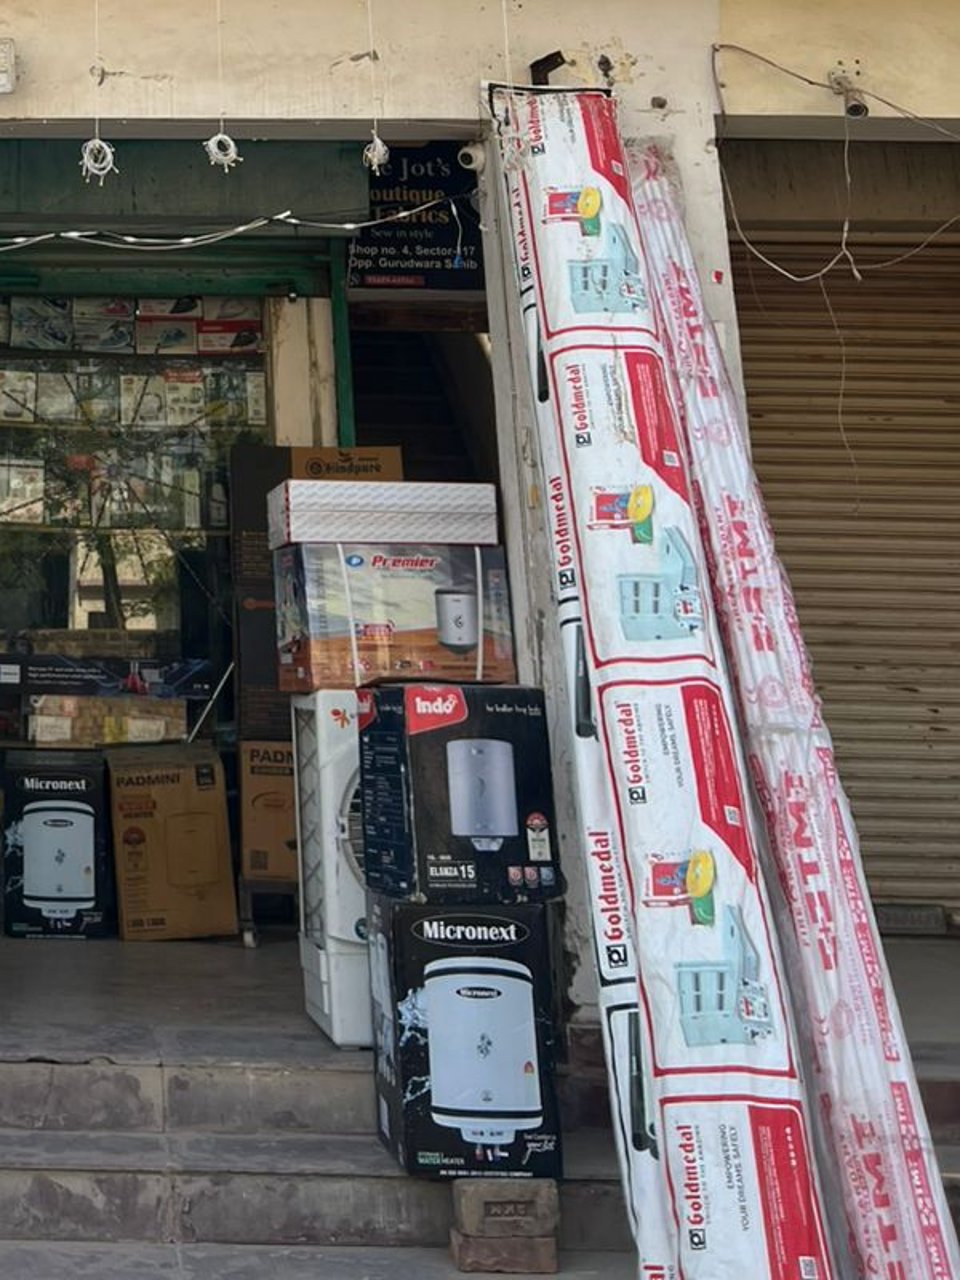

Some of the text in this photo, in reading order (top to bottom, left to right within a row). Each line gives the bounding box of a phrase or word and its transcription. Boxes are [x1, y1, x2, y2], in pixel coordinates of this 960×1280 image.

[548, 476, 573, 568] Goldmedal
[371, 555, 437, 569] Premier
[615, 702, 642, 784] Goldmedal
[24, 777, 86, 791] Micronext
[116, 774, 180, 787] PADMINI
[460, 865, 475, 879] 15
[588, 829, 625, 941] Goldmedal
[423, 921, 517, 941] Micronext
[676, 1125, 705, 1225] Goldmedal
